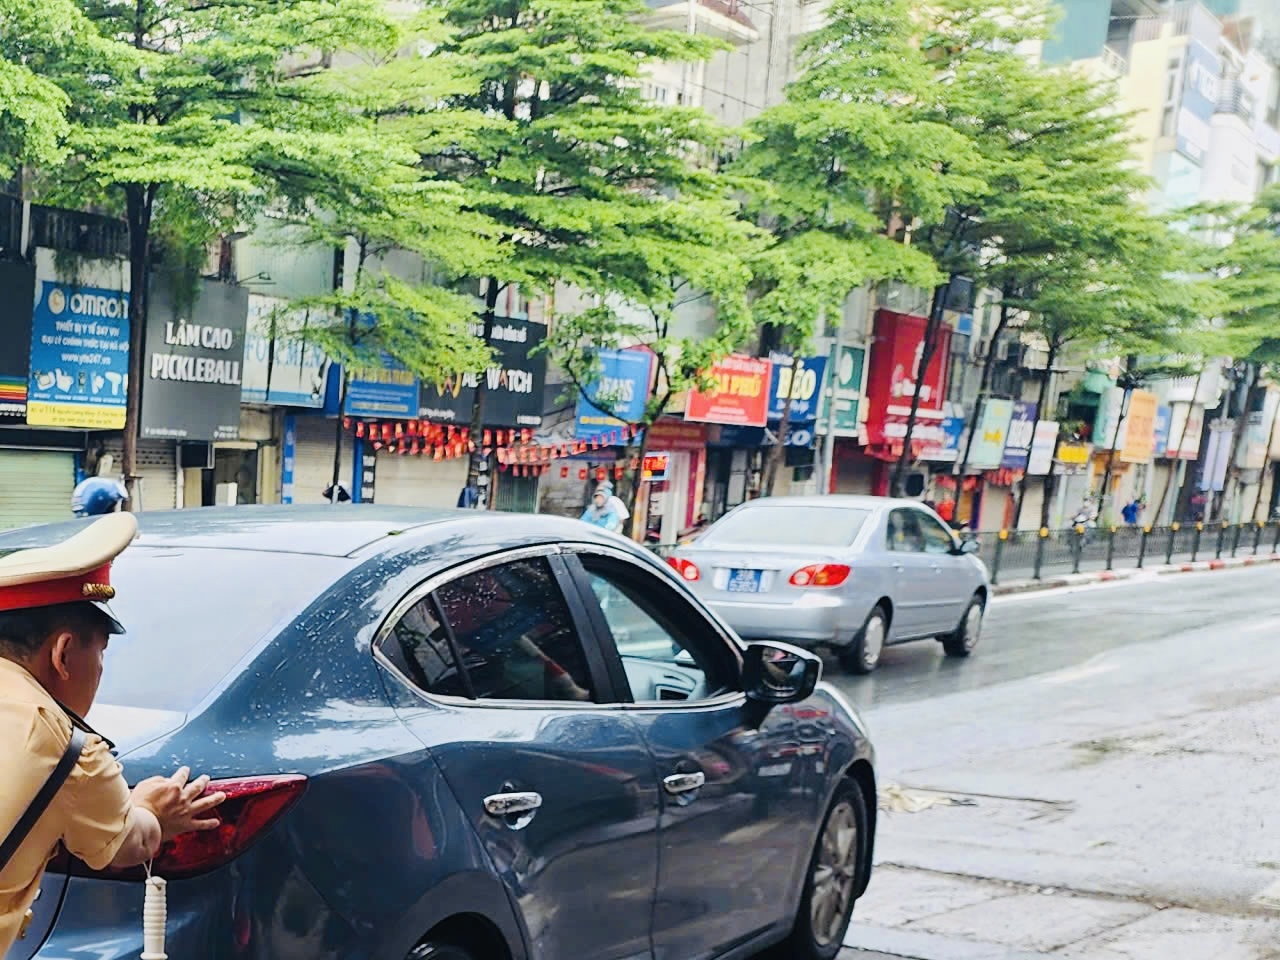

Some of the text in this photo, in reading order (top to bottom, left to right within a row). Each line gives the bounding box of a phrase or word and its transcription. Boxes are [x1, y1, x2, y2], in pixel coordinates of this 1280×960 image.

[201, 326, 232, 350] CAO
[151, 352, 241, 385] PICKLEBALL
[487, 367, 533, 394] WATCH
